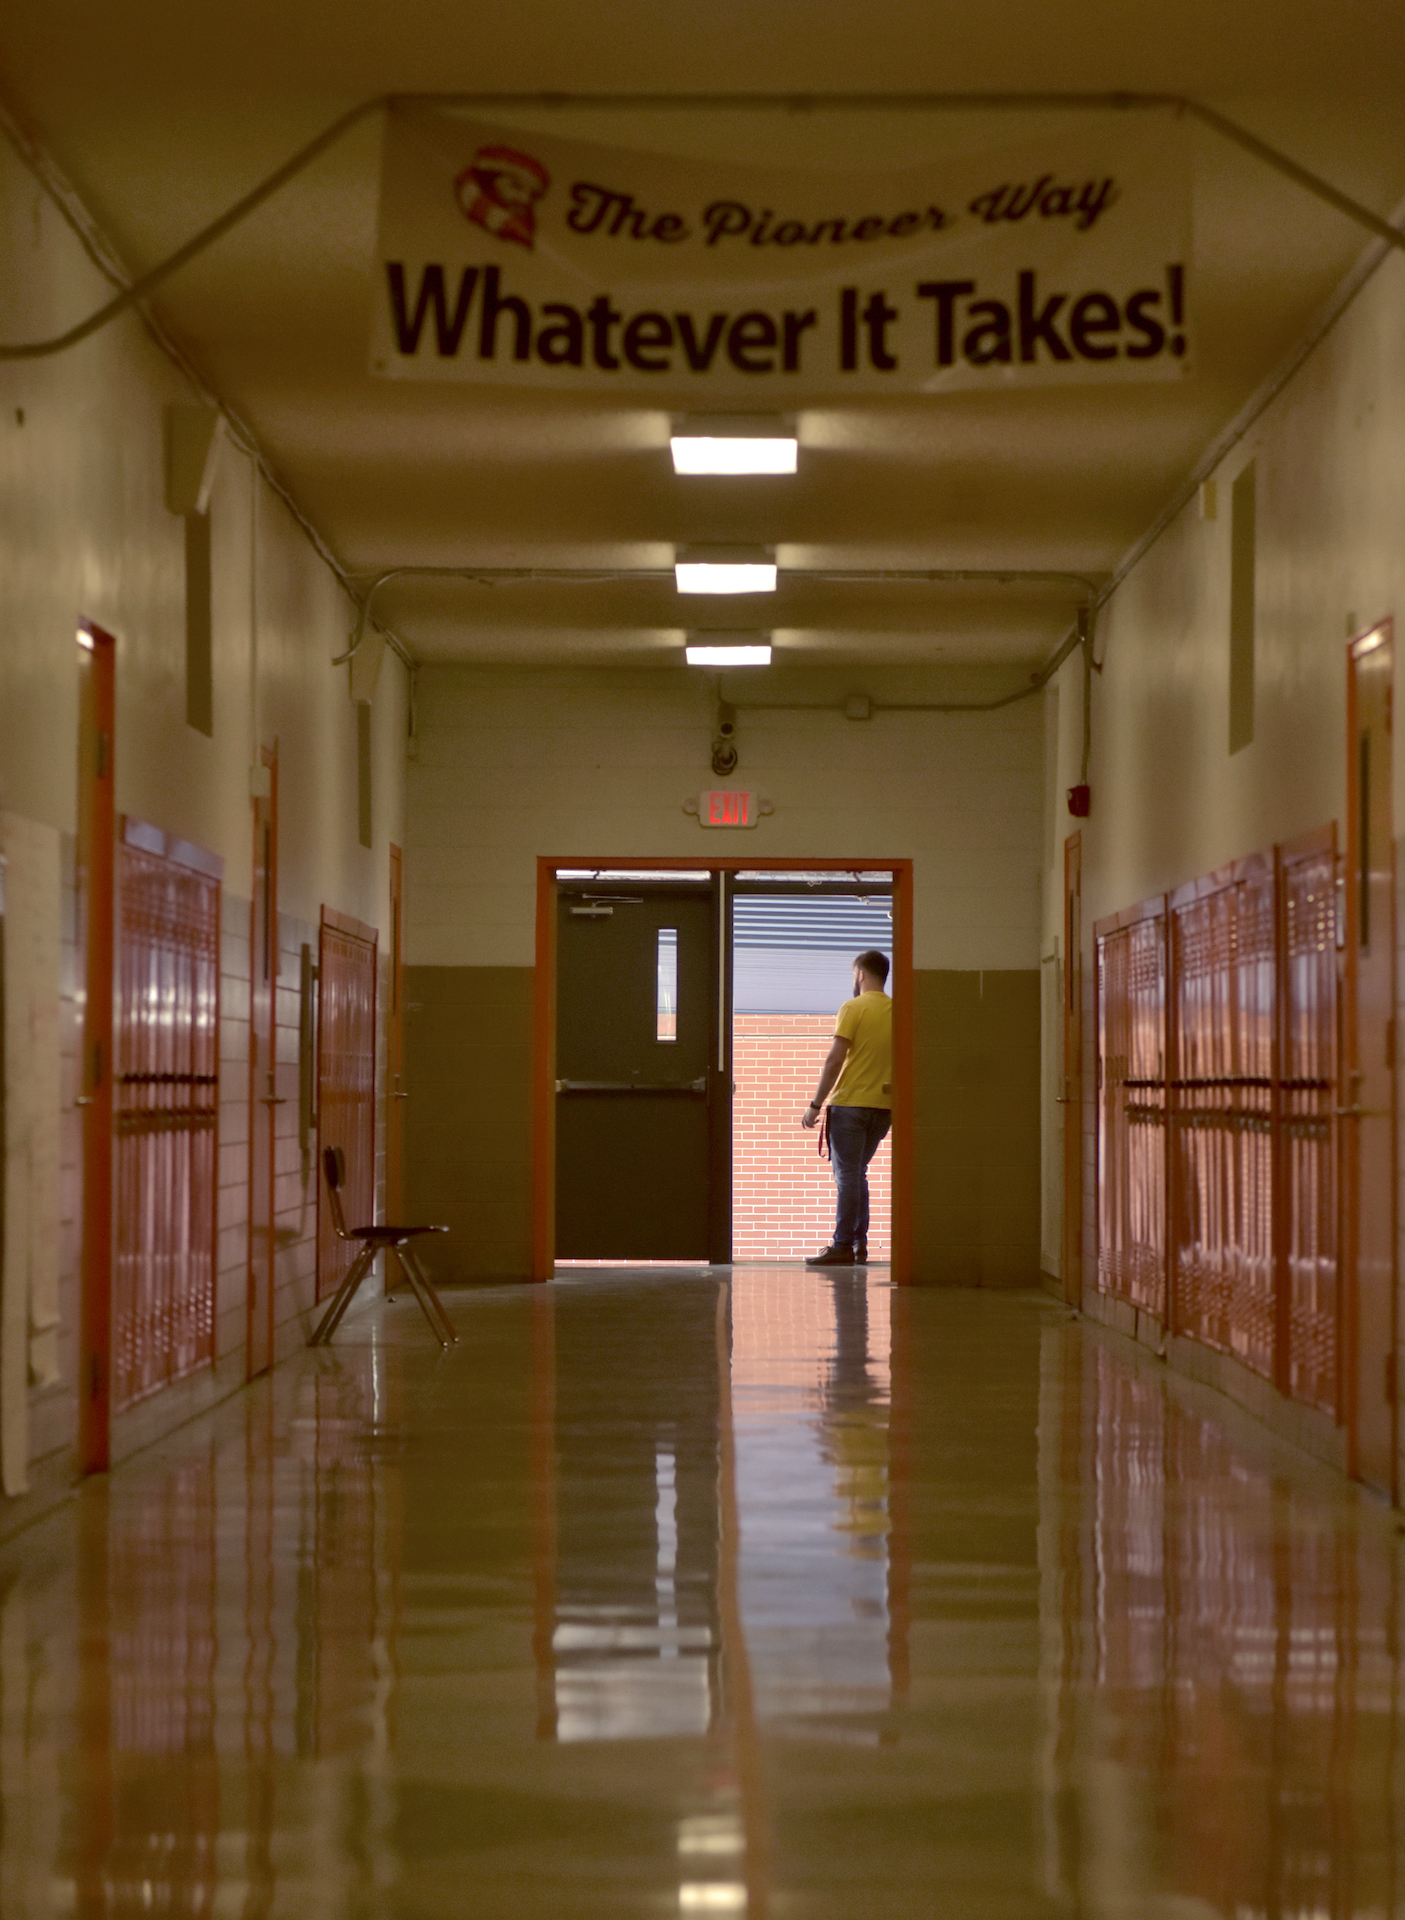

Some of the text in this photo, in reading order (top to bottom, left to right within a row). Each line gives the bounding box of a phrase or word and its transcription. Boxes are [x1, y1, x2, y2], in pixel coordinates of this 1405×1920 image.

[566, 174, 1117, 247] The Pioneer Way
[386, 262, 1186, 372] Whatever It Takes!
[709, 792, 750, 824] EXIT
